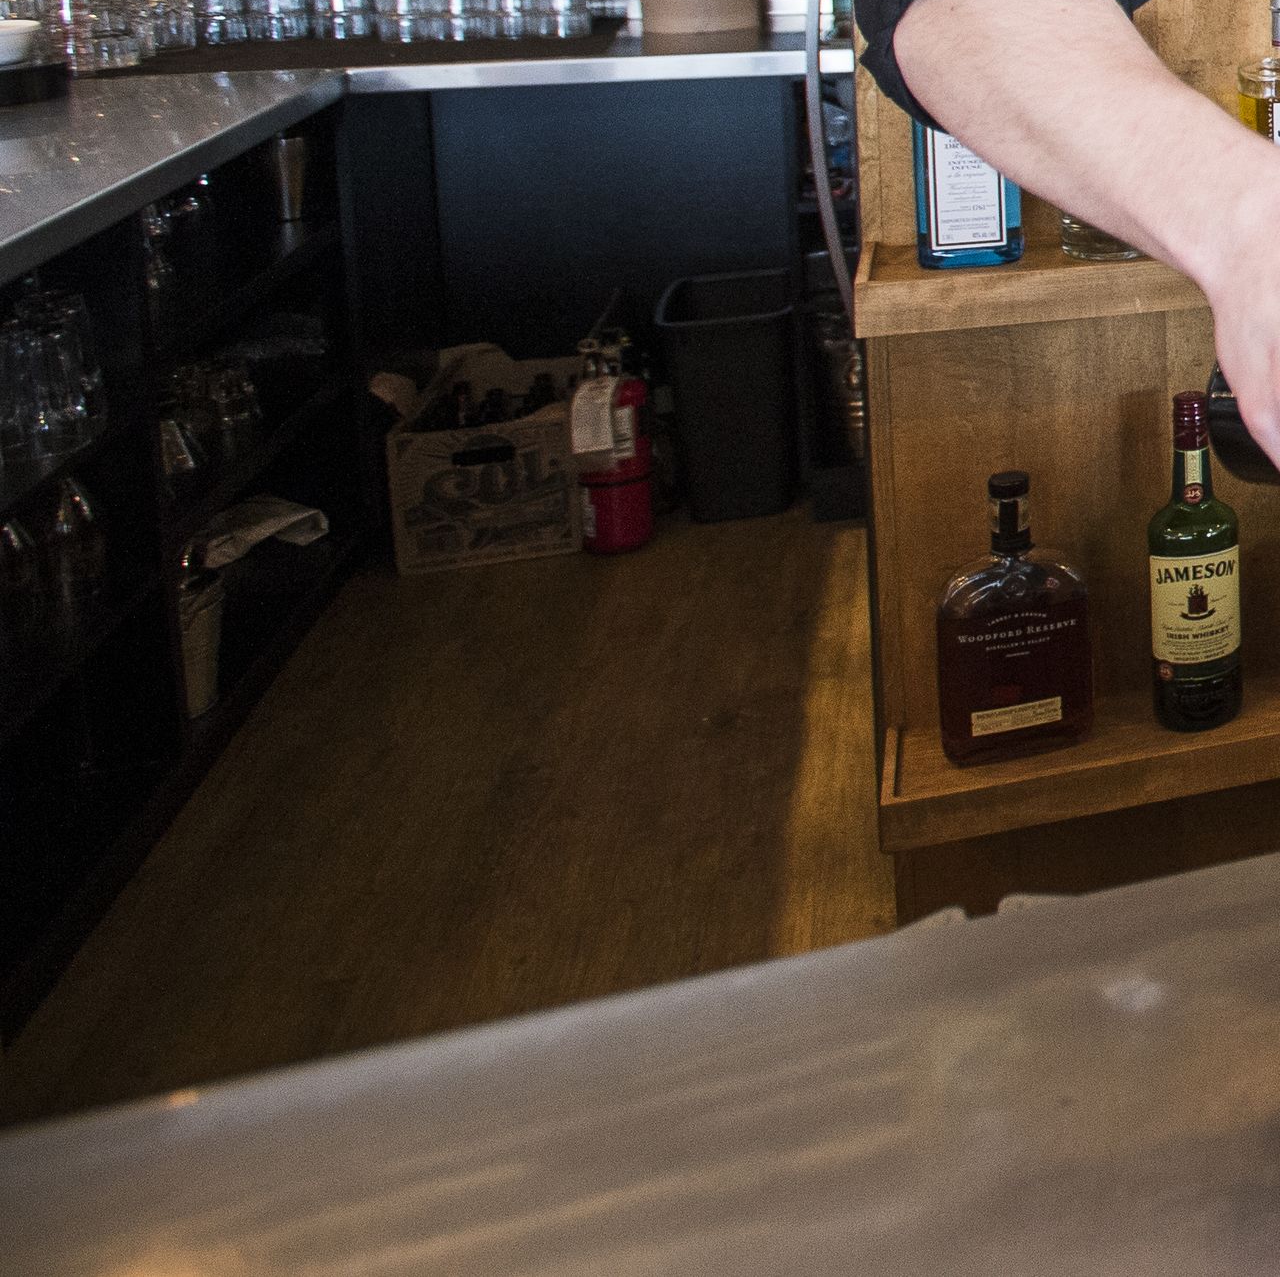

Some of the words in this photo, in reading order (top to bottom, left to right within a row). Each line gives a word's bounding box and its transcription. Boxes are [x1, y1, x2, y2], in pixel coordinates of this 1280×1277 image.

[1156, 559, 1236, 585] JAMESON
[958, 628, 1023, 643] WOODFORD
[1026, 618, 1077, 635] RESERVE
